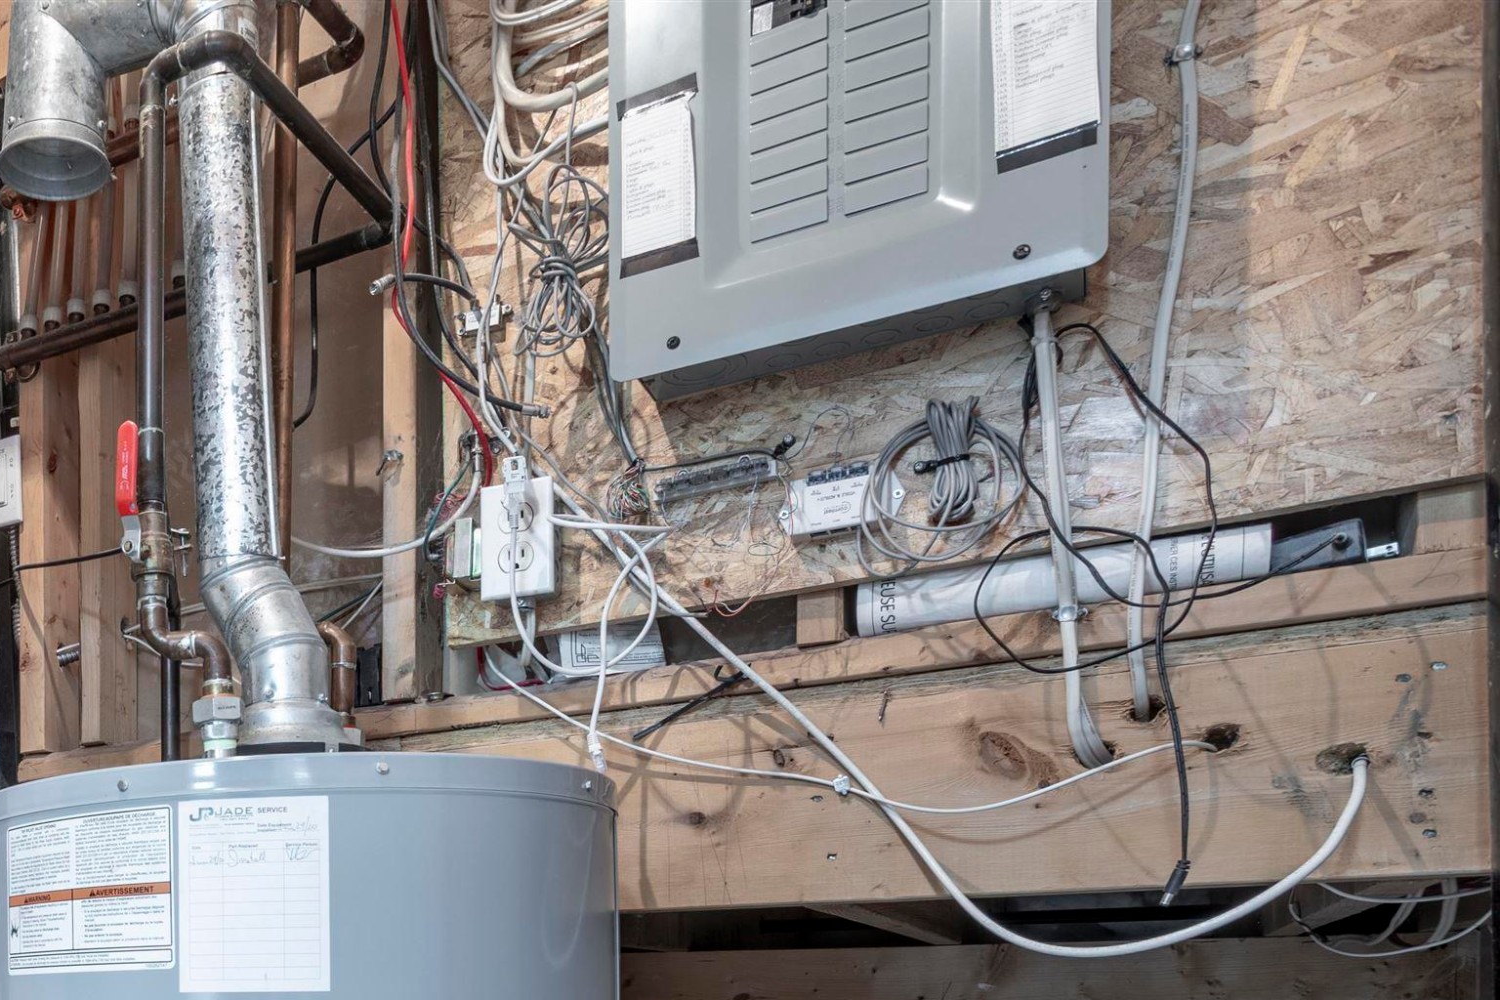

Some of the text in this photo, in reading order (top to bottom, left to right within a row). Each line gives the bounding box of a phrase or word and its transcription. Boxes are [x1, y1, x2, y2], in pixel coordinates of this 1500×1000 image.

[215, 807, 254, 816] JADE
[95, 886, 154, 896] AVERTISSEMENT
[28, 894, 52, 903] WARNING
